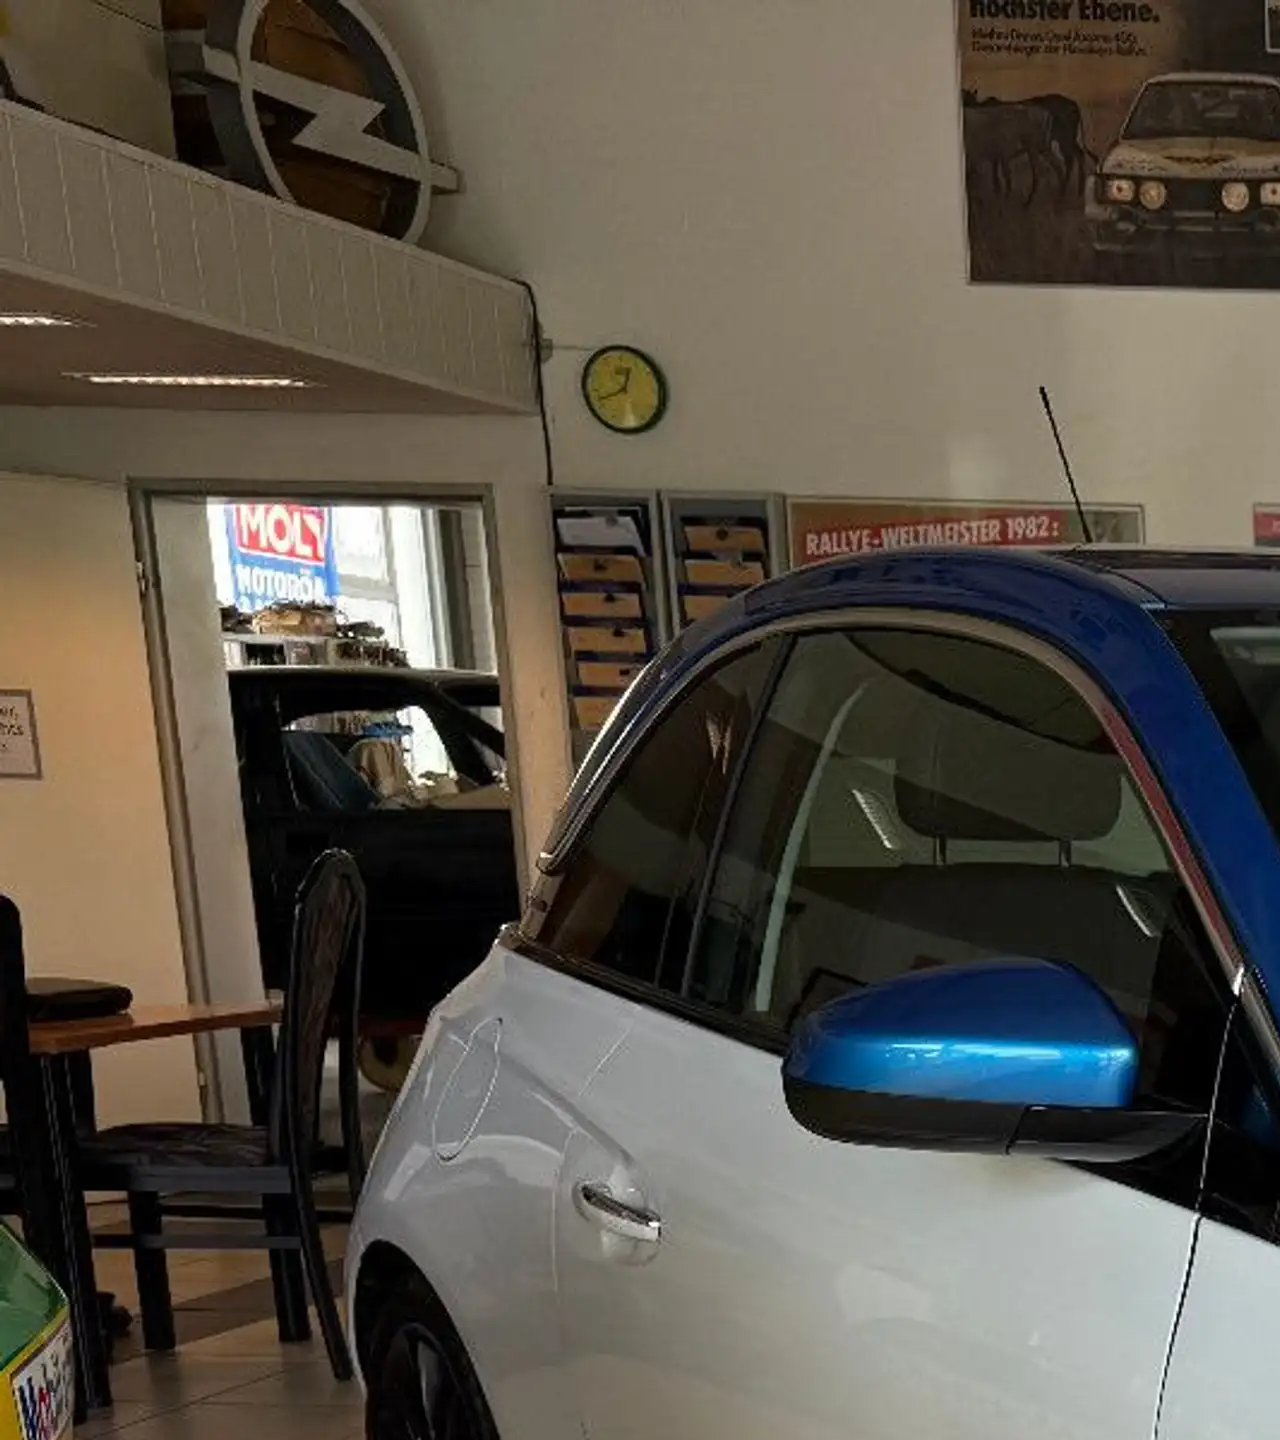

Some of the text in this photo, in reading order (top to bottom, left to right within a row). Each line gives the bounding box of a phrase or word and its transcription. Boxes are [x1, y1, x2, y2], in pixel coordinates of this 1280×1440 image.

[239, 503, 325, 560] MOLY
[806, 515, 1060, 555] RALLYE-WELTMEISTER 1982:
